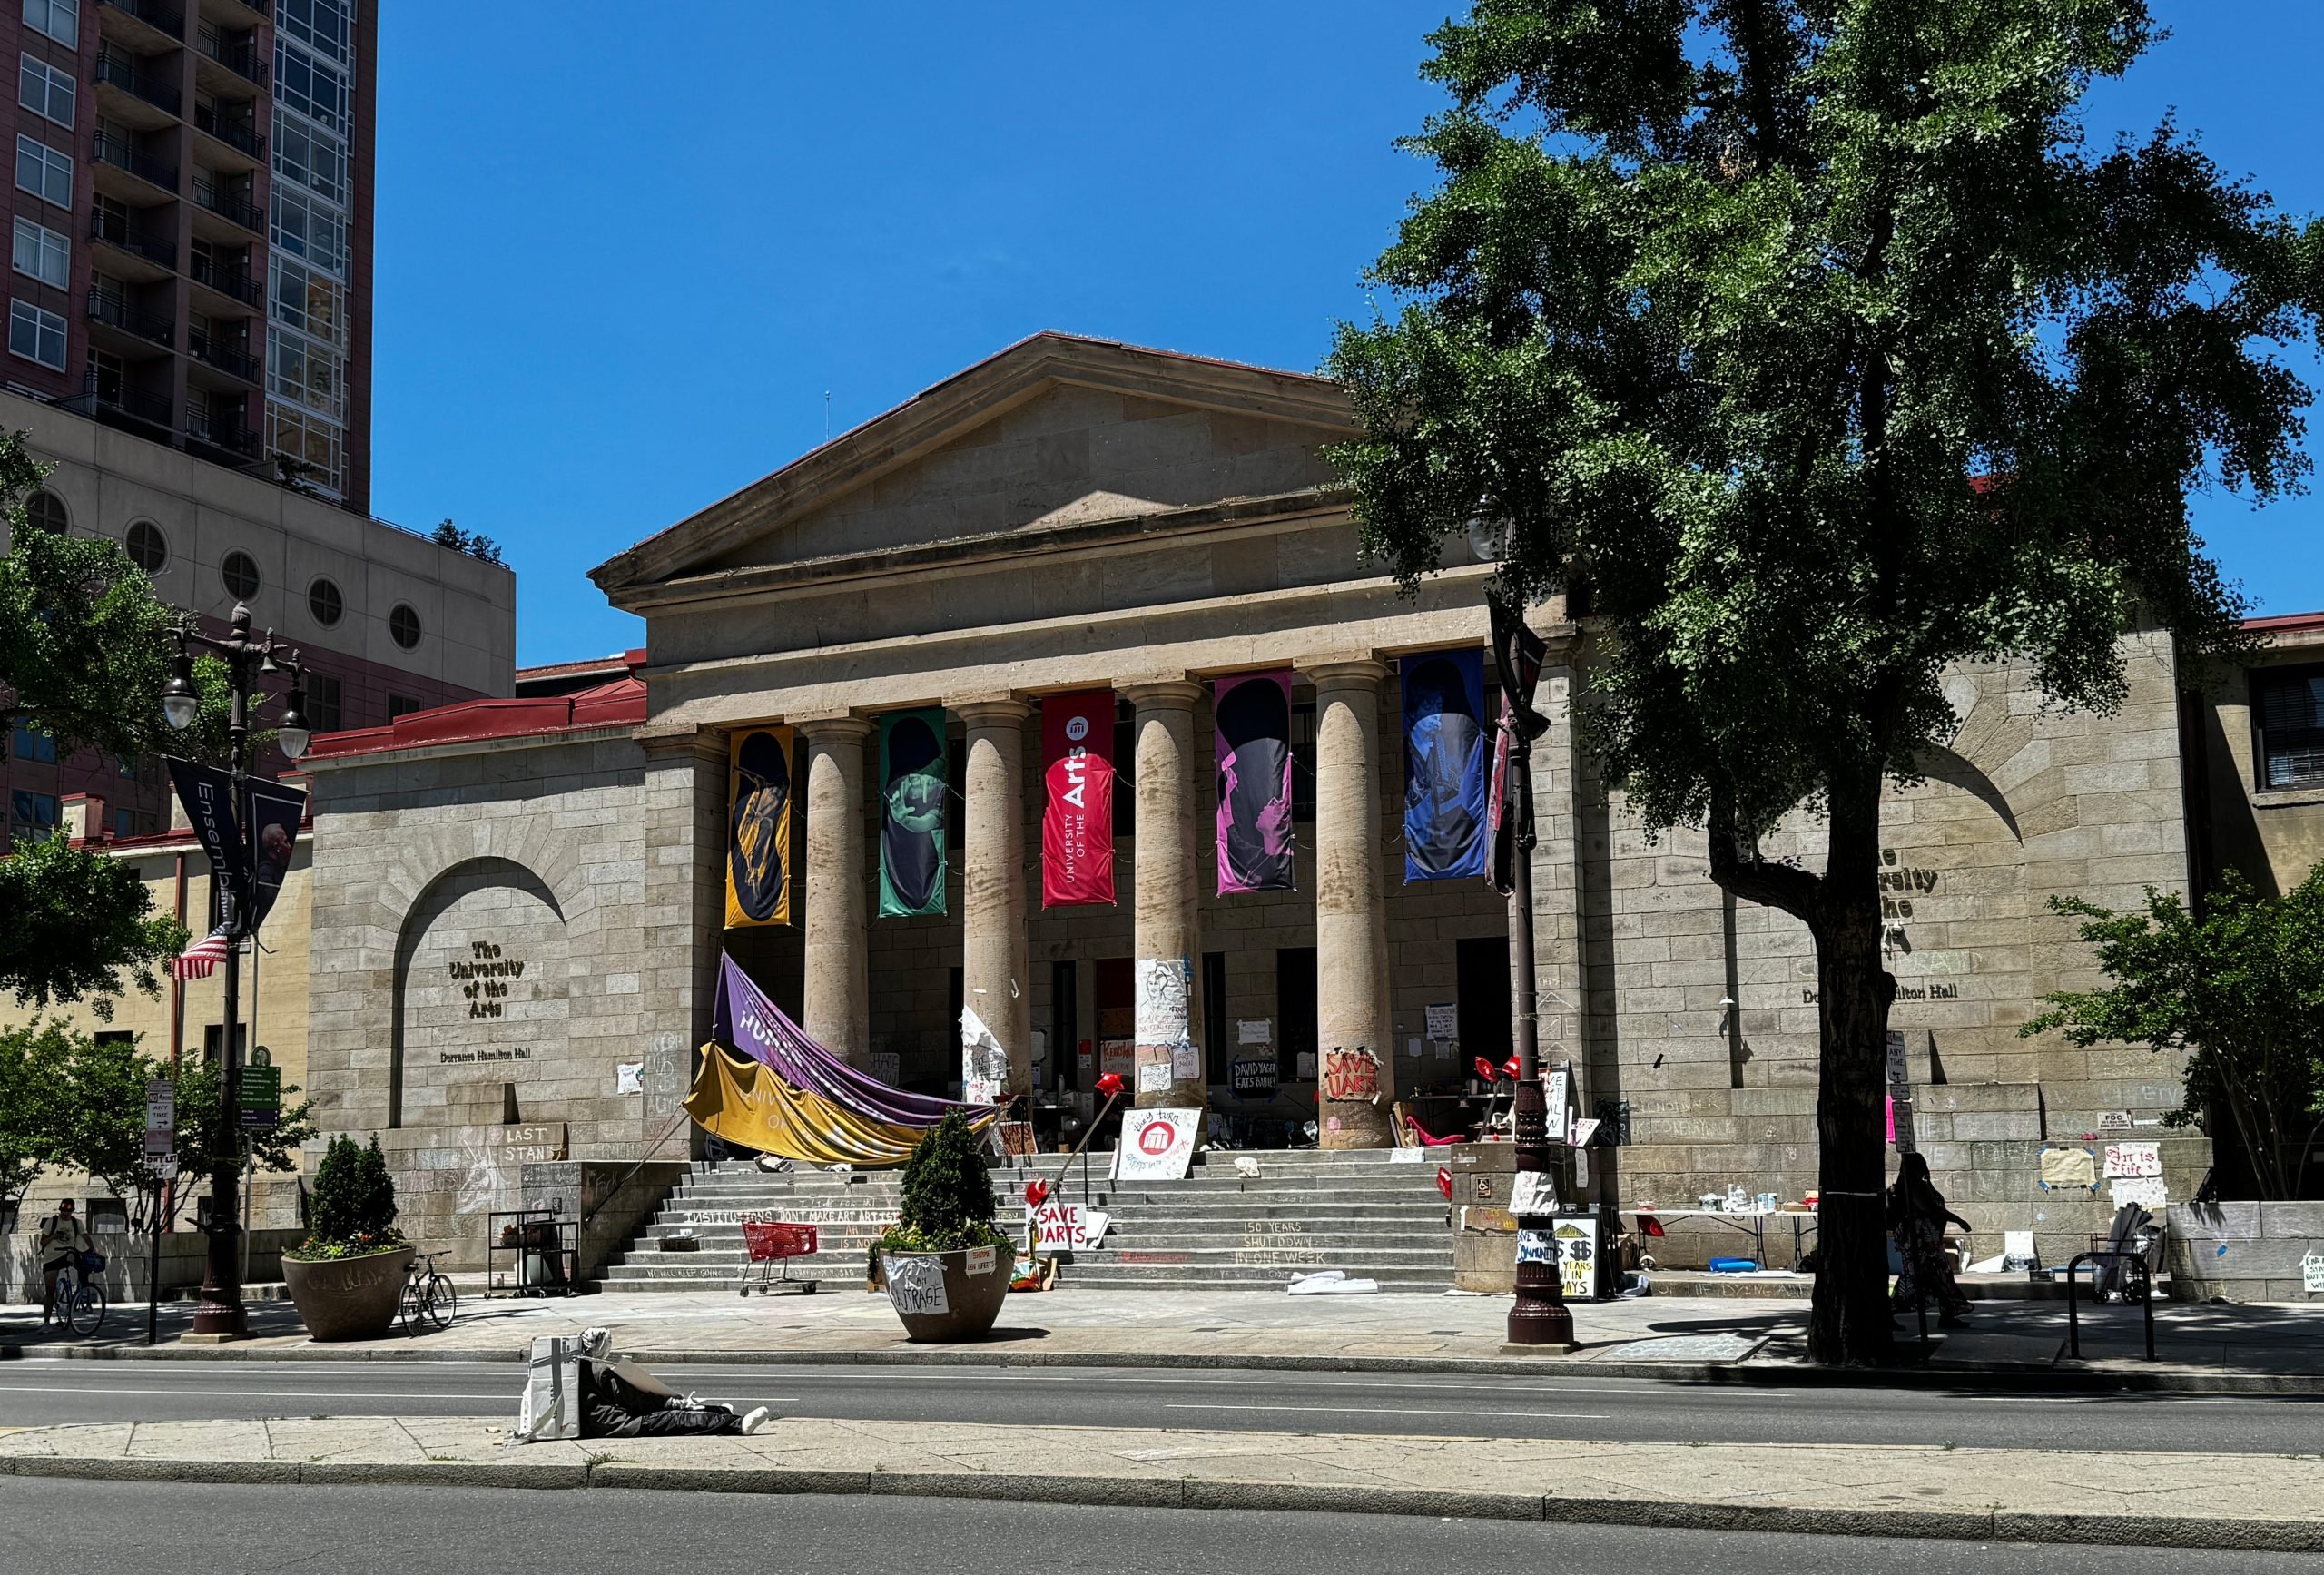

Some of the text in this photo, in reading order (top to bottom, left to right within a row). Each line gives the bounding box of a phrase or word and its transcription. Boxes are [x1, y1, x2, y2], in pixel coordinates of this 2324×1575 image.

[1062, 745, 1088, 809] Arts
[1076, 813, 1085, 858] OF THE
[1064, 814, 1074, 883] UNIVERSITY
[1879, 867, 1938, 894] rsity
[1880, 895, 1914, 919] he
[471, 940, 501, 959] The
[448, 959, 525, 979] University
[463, 979, 508, 999] of the
[1930, 983, 1958, 999] Hall
[469, 1000, 502, 1019] Arts
[440, 1047, 530, 1063] Dorrance Hamilton Hall
[1889, 1048, 1903, 1057] ANY
[1235, 1062, 1275, 1076] DAVID YAGER
[1326, 1052, 1375, 1075] SAVE
[1236, 1077, 1275, 1088] EATS BABIES
[507, 1127, 547, 1143] LAST
[504, 1146, 563, 1162] STAND
[2107, 1147, 2155, 1166] Art is
[808, 1210, 835, 1222] MAKE
[837, 1210, 856, 1222] ART
[1039, 1206, 1078, 1224] SAVE
[1244, 1221, 1302, 1233] 150 YEARS
[1037, 1226, 1086, 1245] UARTS
[1243, 1235, 1312, 1247] SHUT DOWN
[840, 1240, 850, 1248] IS
[1236, 1252, 1325, 1265] IN ONE WEEK
[1563, 1261, 1592, 1271] YEARS
[646, 1269, 656, 1277] WE
[660, 1269, 675, 1277] WILL
[678, 1268, 696, 1277] KEEP
[1571, 1270, 1582, 1280] IN
